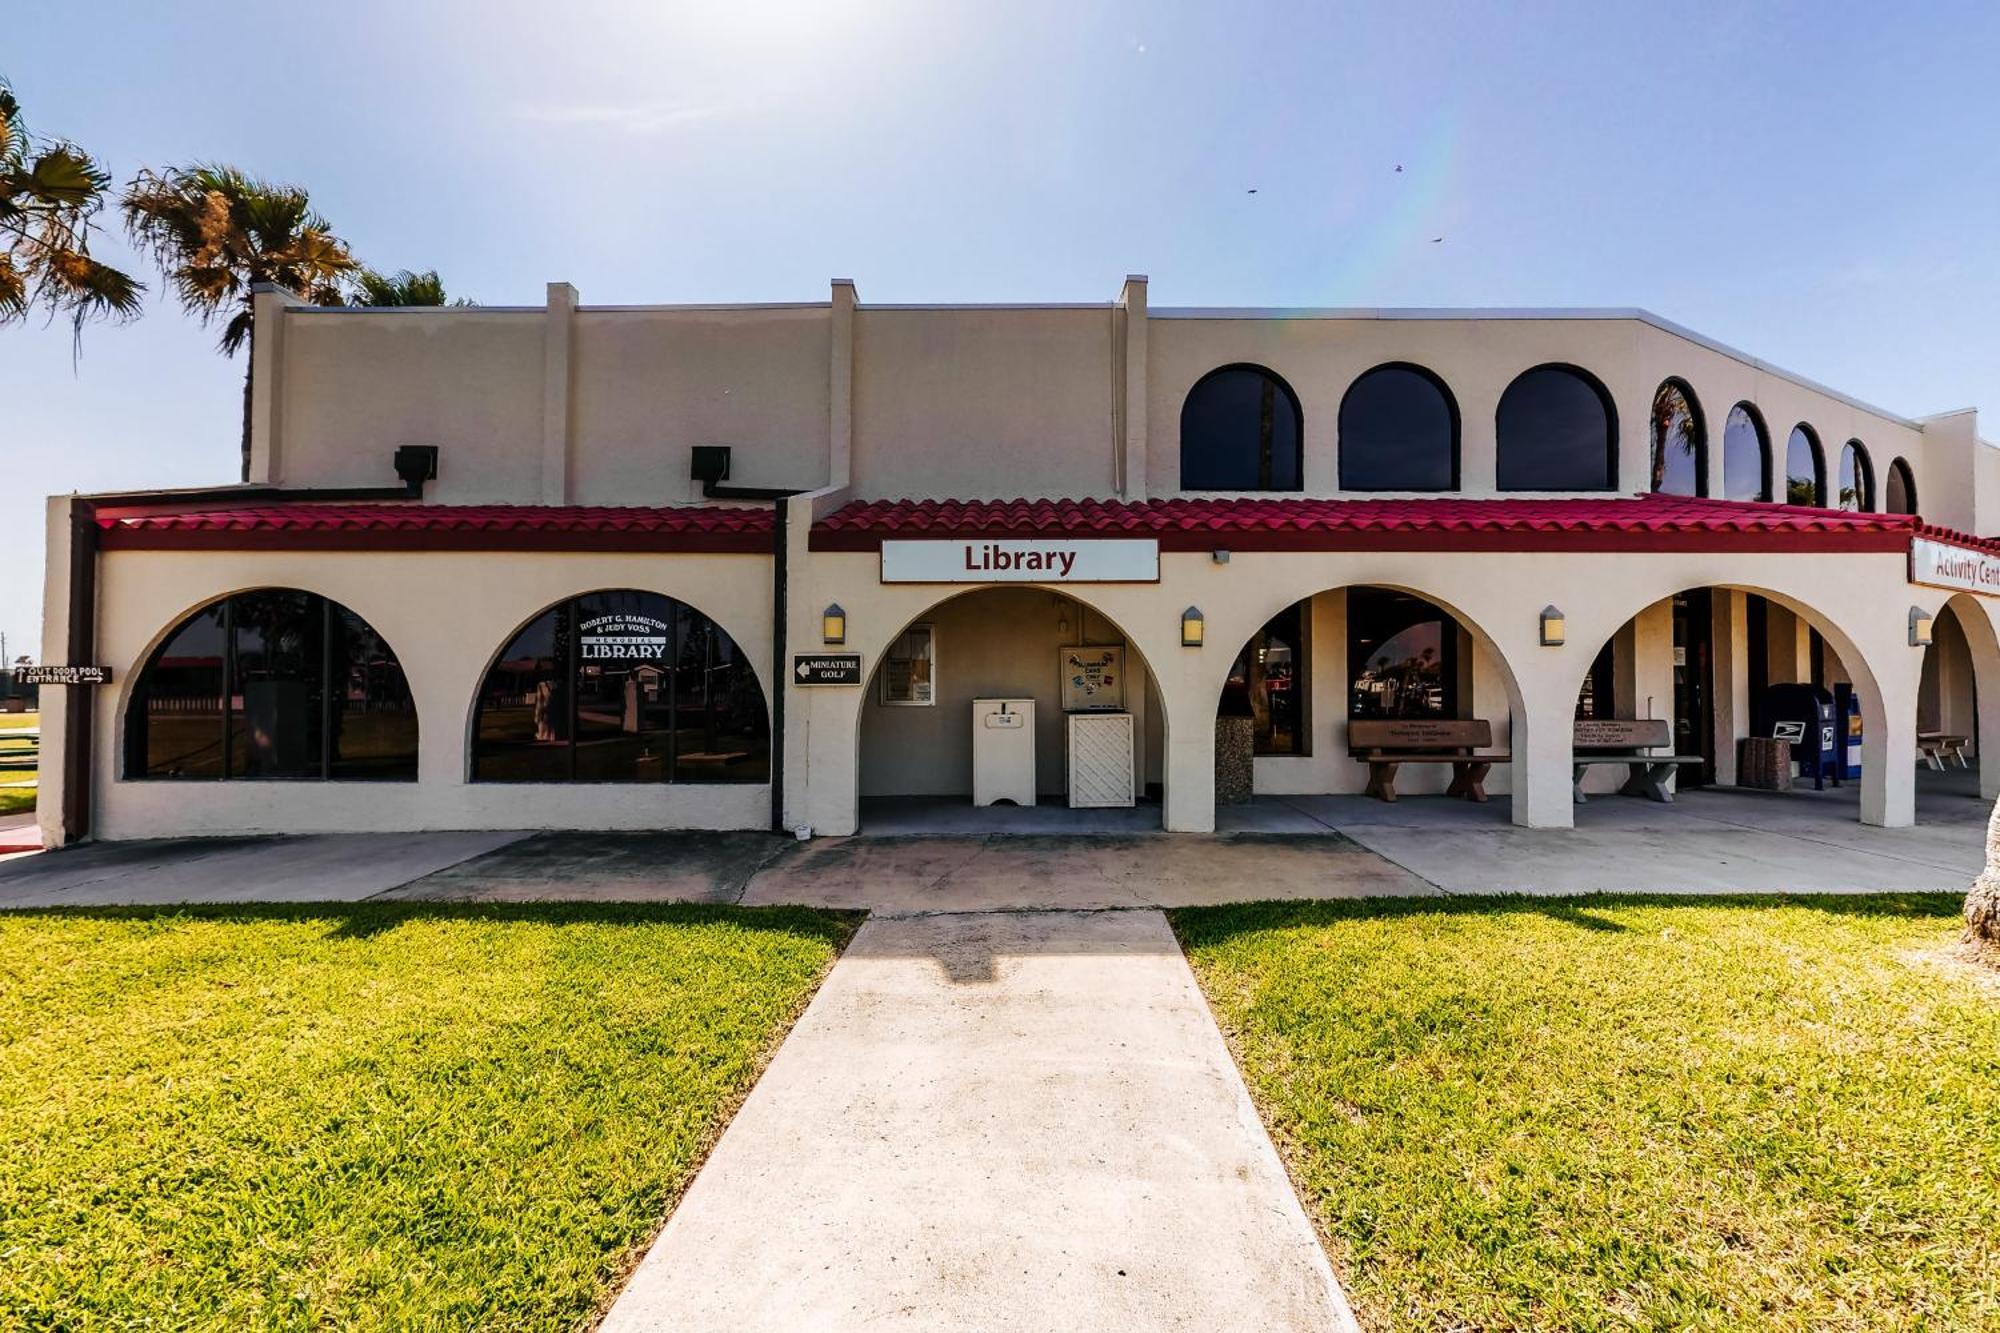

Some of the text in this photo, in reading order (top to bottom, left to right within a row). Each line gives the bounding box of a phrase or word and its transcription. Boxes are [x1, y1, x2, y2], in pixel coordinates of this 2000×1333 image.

[965, 545, 1076, 576] Library
[1936, 551, 1977, 587] Activity
[580, 615, 613, 631] ROBERT
[625, 615, 667, 631] HAMILTON
[597, 626, 603, 634] &
[627, 624, 650, 634] VOSS
[581, 645, 666, 658] LIBRARY
[810, 660, 857, 669] MINIATURE
[79, 667, 104, 676] POOL
[820, 670, 846, 678] GOLF
[26, 675, 79, 684] ENTRANCE
